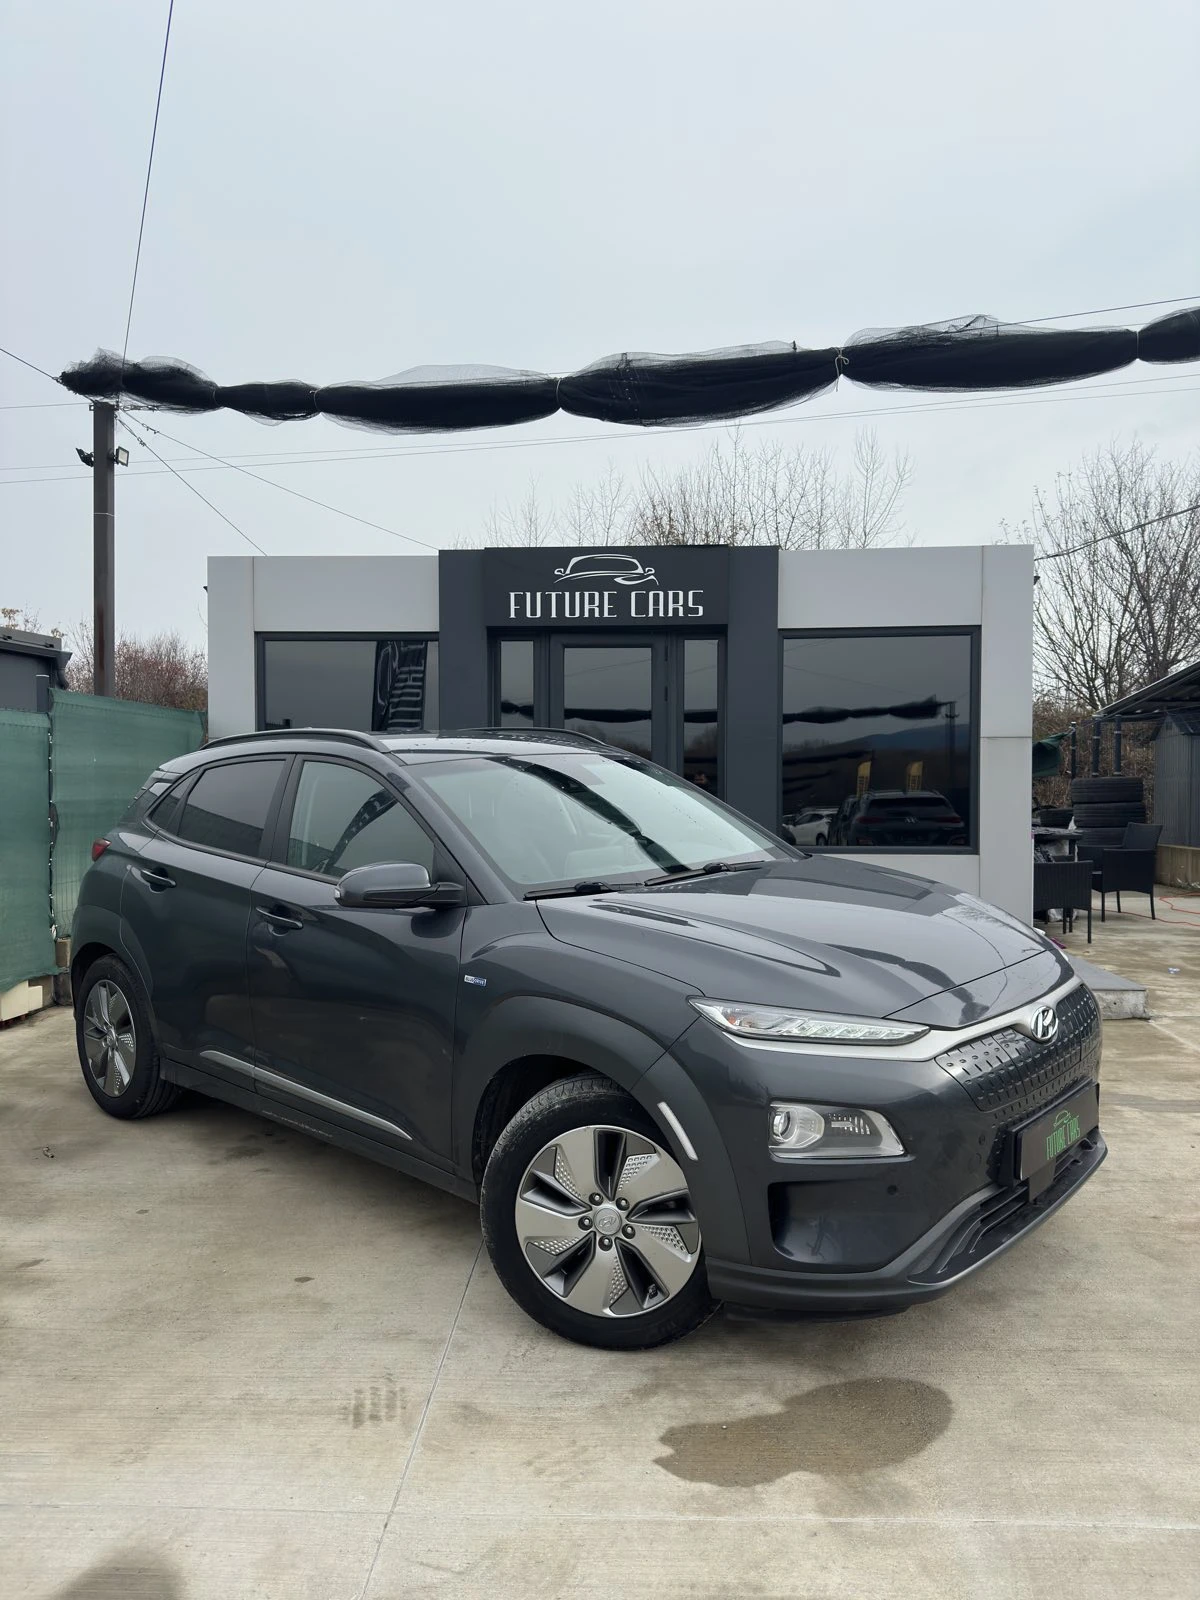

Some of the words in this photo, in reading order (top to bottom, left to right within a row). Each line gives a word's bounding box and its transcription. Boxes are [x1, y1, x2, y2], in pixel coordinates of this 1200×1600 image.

[509, 591, 617, 618] FUTURE
[630, 590, 704, 617] CARS
[387, 659, 424, 731] UTURE
